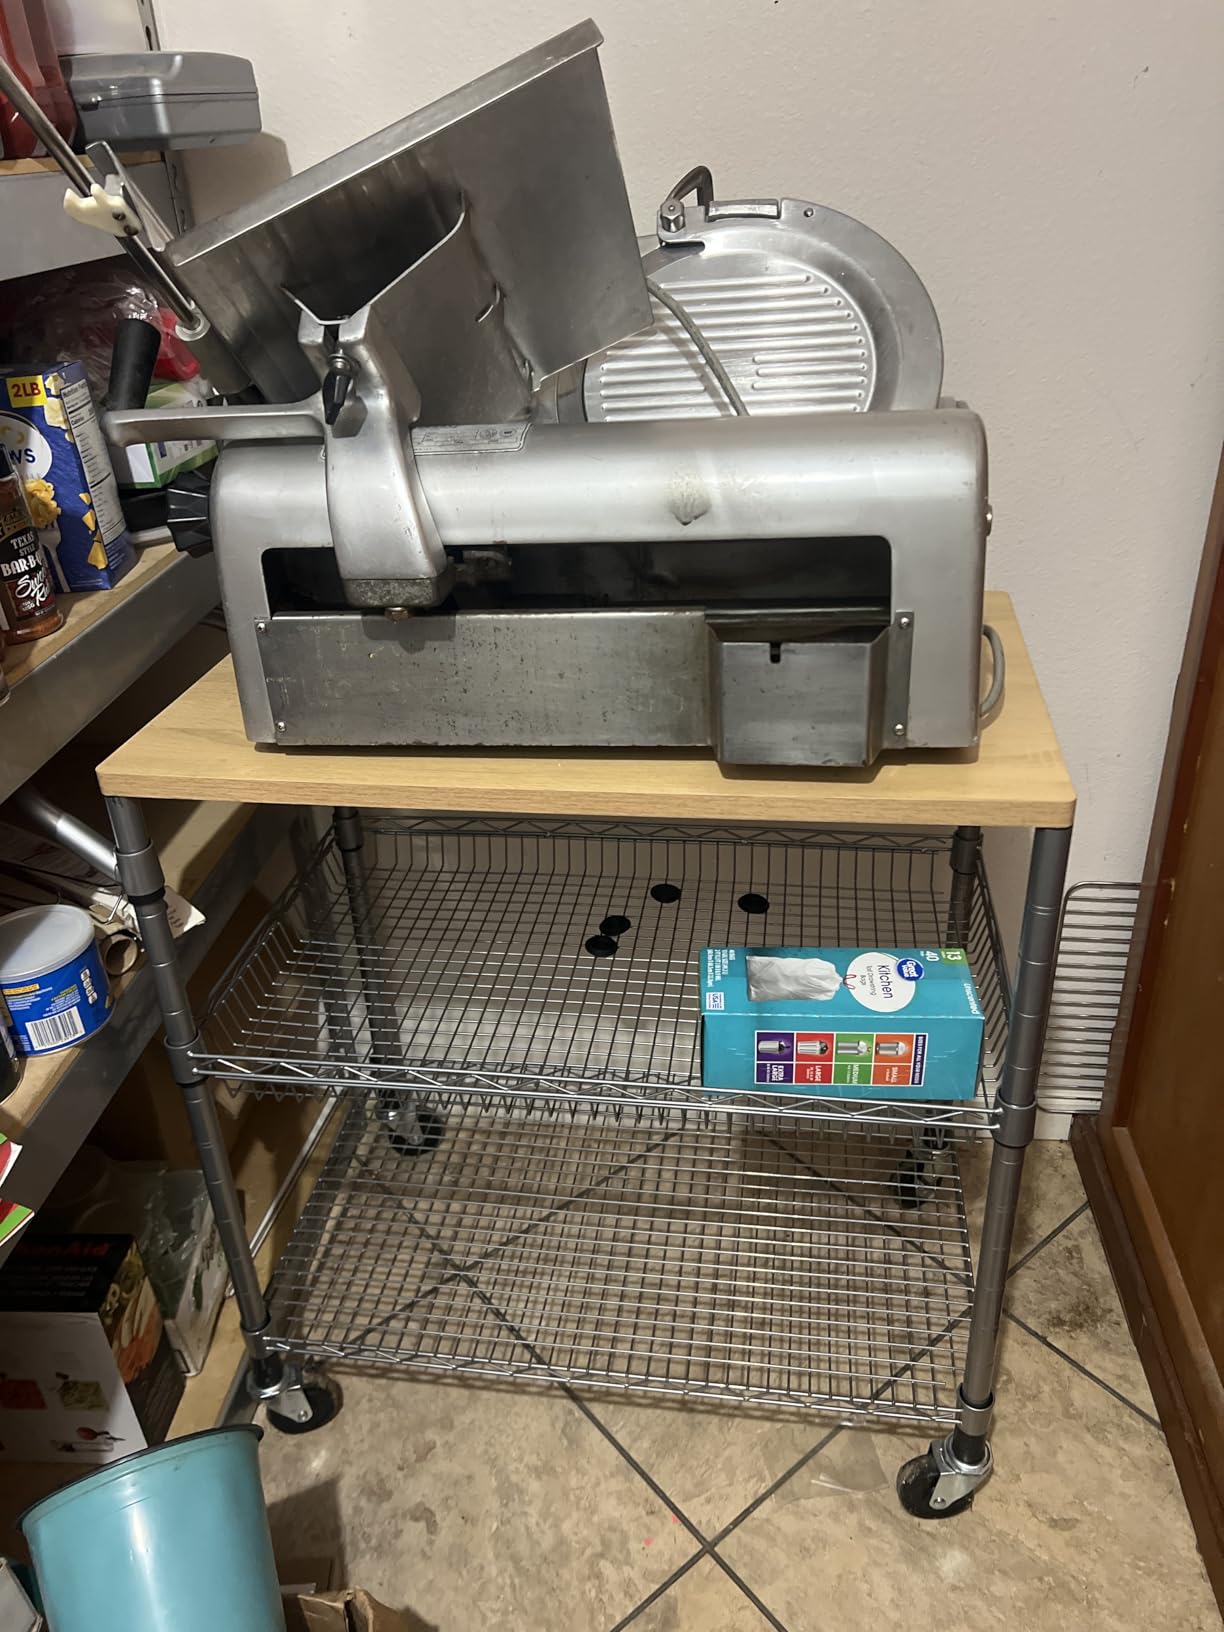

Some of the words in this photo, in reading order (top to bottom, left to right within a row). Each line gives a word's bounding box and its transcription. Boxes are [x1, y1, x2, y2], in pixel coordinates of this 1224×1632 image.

[11, 382, 41, 398] 2LB
[10, 530, 35, 551] TEXAS
[925, 950, 940, 961] 40
[945, 951, 962, 961] 13
[906, 960, 919, 977] Great
[859, 974, 868, 986] Bags
[866, 972, 878, 996] Drawstring
[876, 964, 894, 999] Kitchen
[852, 1064, 860, 1084] MEDIUM
